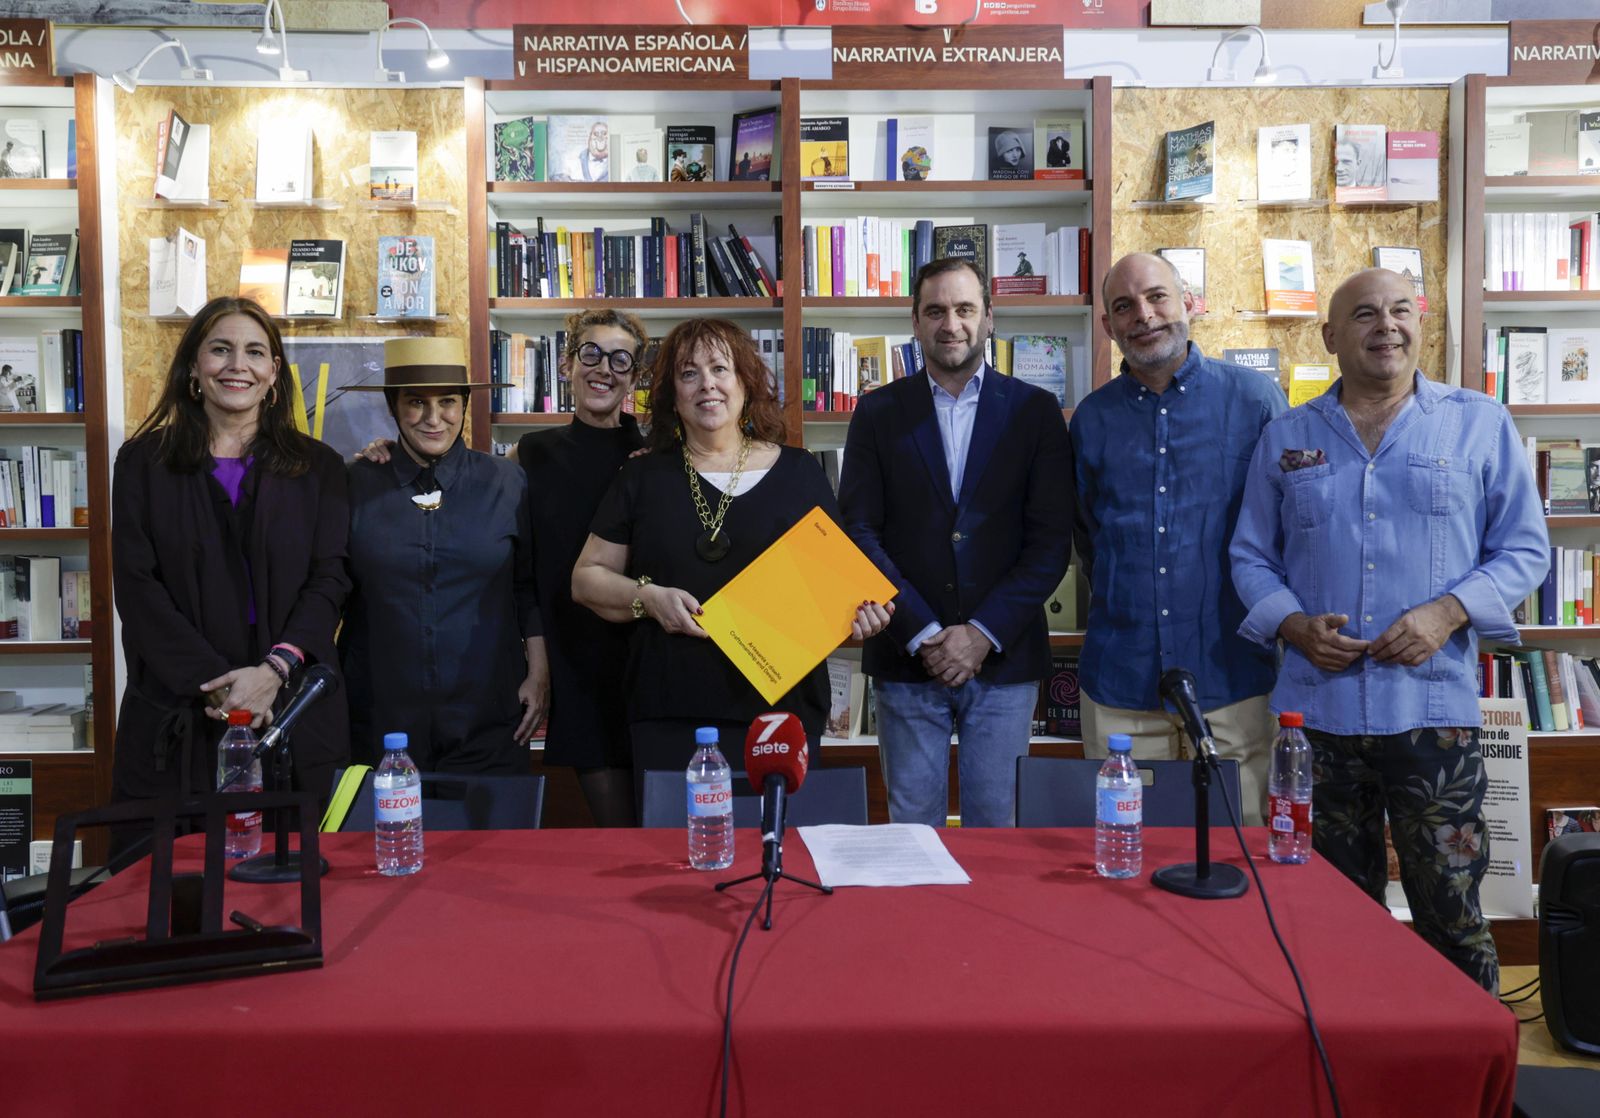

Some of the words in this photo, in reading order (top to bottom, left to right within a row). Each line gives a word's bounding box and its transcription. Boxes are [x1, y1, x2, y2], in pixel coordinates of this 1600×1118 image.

[523, 35, 629, 51] NARRATIVA
[634, 32, 735, 51] ESPAÑOLA
[833, 47, 937, 62] NARRATIVA
[942, 46, 1062, 62] EXTRANJERA
[536, 56, 736, 73] HISPANOAMERICANA
[1170, 126, 1212, 146] MATHIAS
[1169, 156, 1190, 167] UNA
[1168, 175, 1181, 184] EN
[396, 241, 415, 256] DE
[384, 296, 425, 310] AMOR
[1234, 353, 1270, 361] MATHIAS
[1047, 706, 1057, 718] EL
[757, 713, 790, 744] 7
[1497, 728, 1510, 740] de
[752, 741, 790, 757] siete
[1480, 743, 1523, 760] USHDIE
[378, 794, 421, 809] BEZOYA
[695, 789, 733, 804] BEZOY
